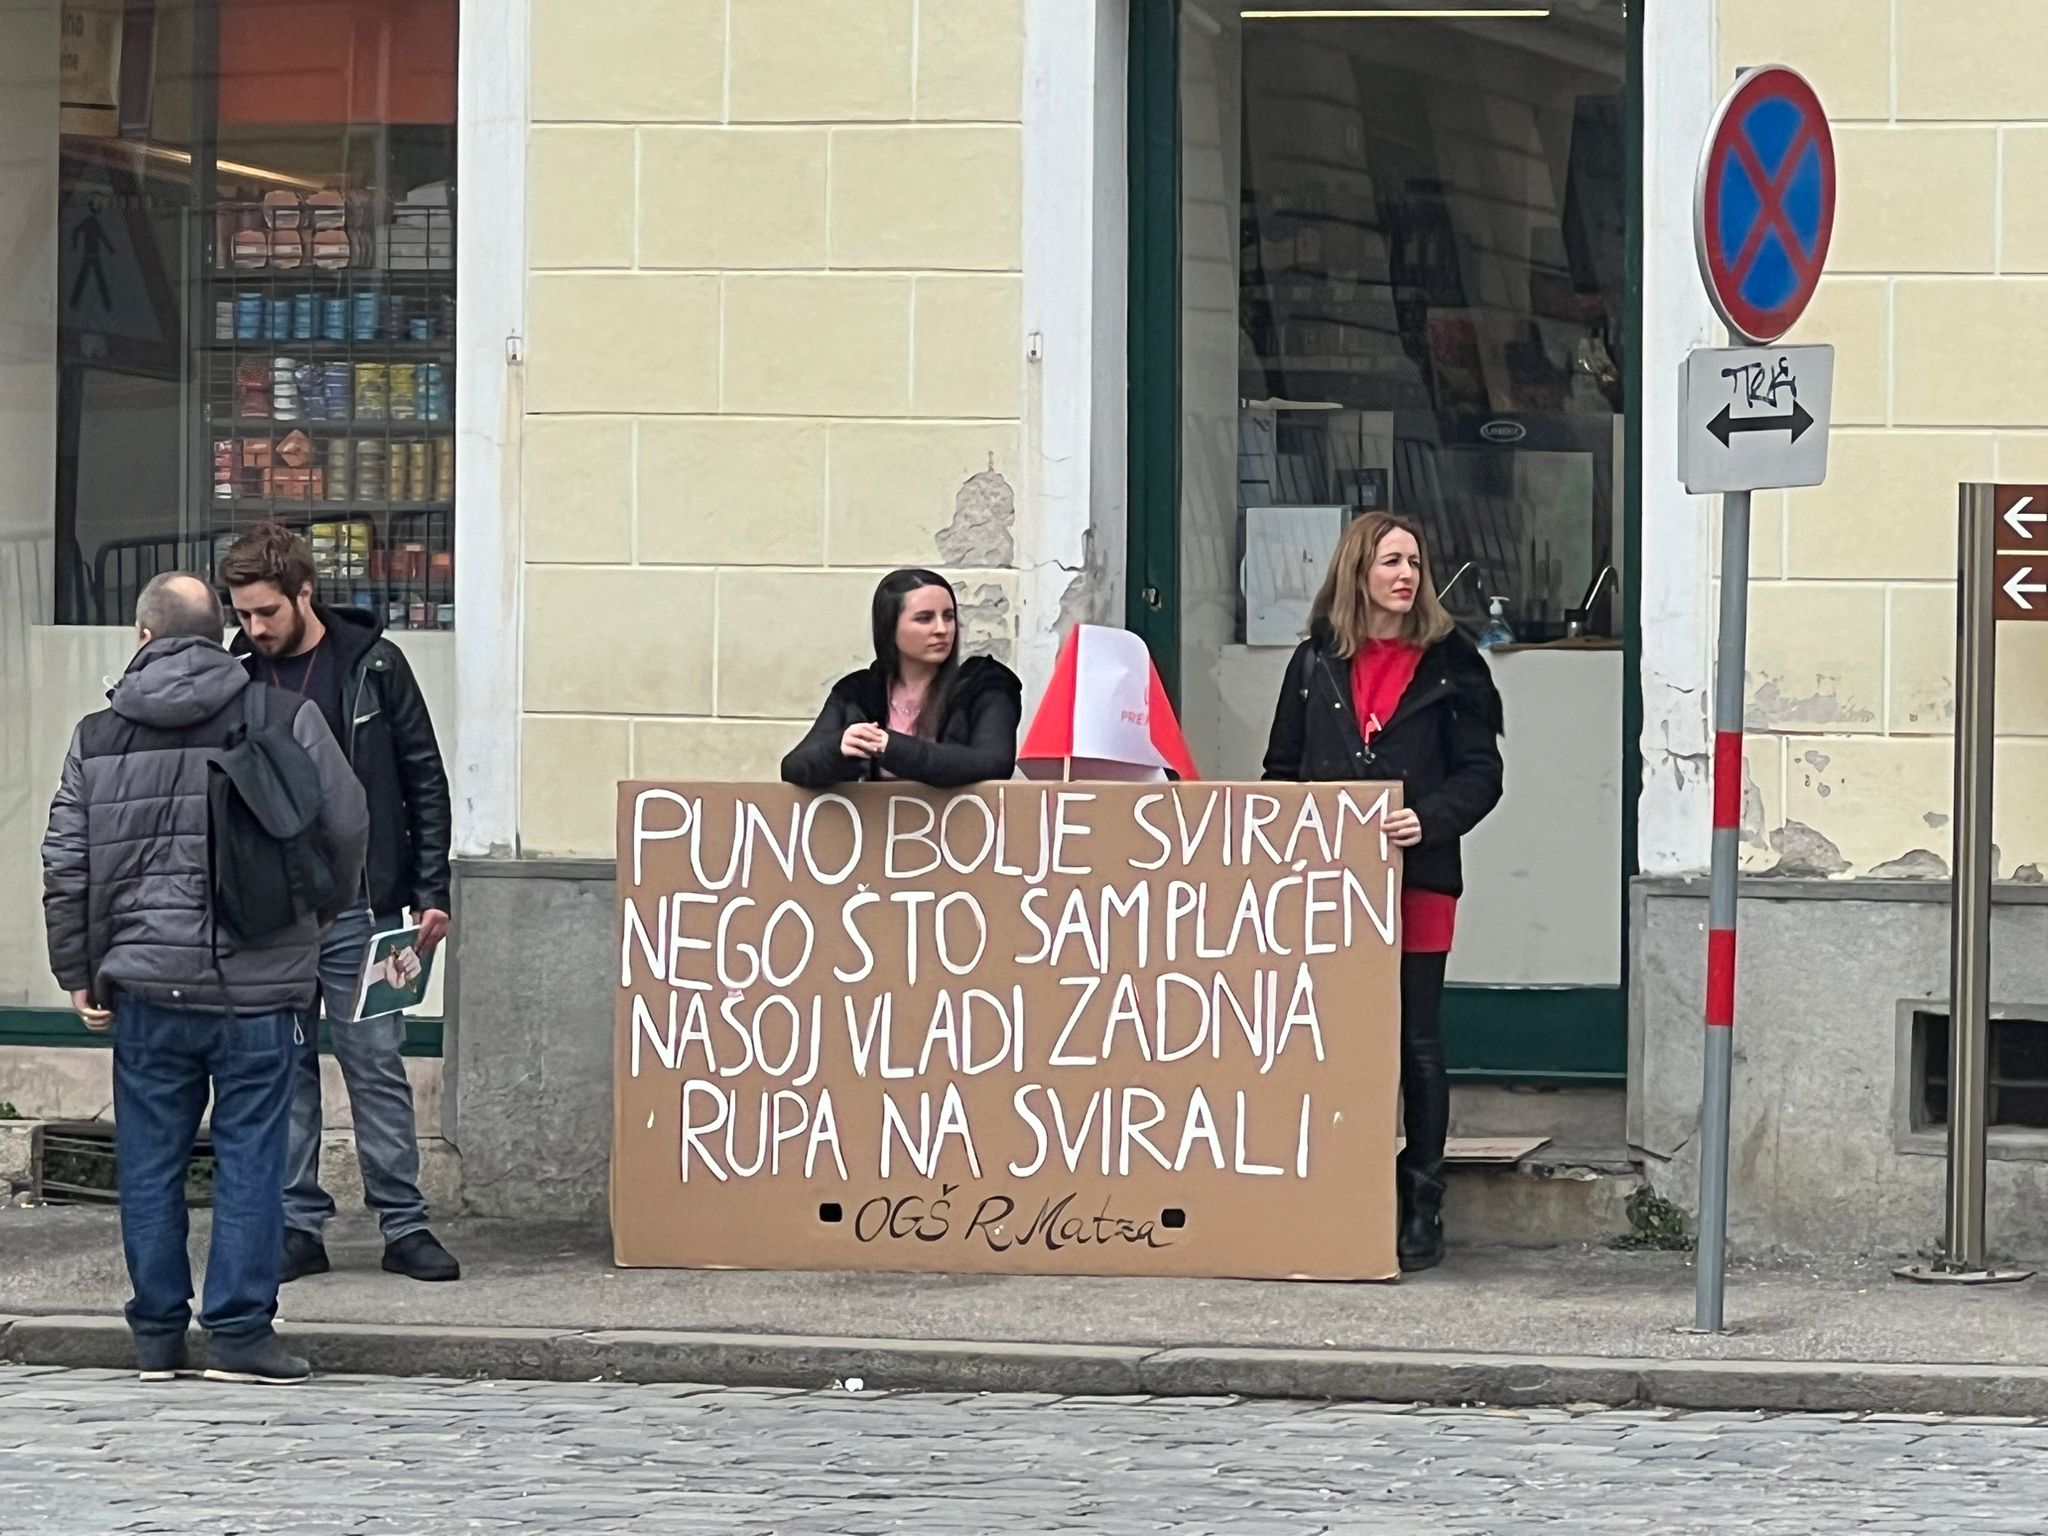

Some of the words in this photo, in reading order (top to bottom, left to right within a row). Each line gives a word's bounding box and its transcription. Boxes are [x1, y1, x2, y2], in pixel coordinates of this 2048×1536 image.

[1120, 710, 1149, 726] PRE
[633, 789, 863, 890] PUNO
[884, 787, 1096, 884] BOLJE
[1128, 787, 1389, 870] SVIRAM
[621, 891, 814, 990] NEGO
[833, 882, 987, 987] ŠTO
[1014, 879, 1149, 974] SAM
[1166, 858, 1394, 961] PLAĆEN
[844, 989, 1024, 1078] VLADI
[1048, 962, 1325, 1074] ZADNJA
[680, 1079, 848, 1182] RUPA
[879, 1081, 982, 1179] NA
[1008, 1084, 1310, 1178] SVIRALI
[855, 1184, 959, 1242] OGŠ
